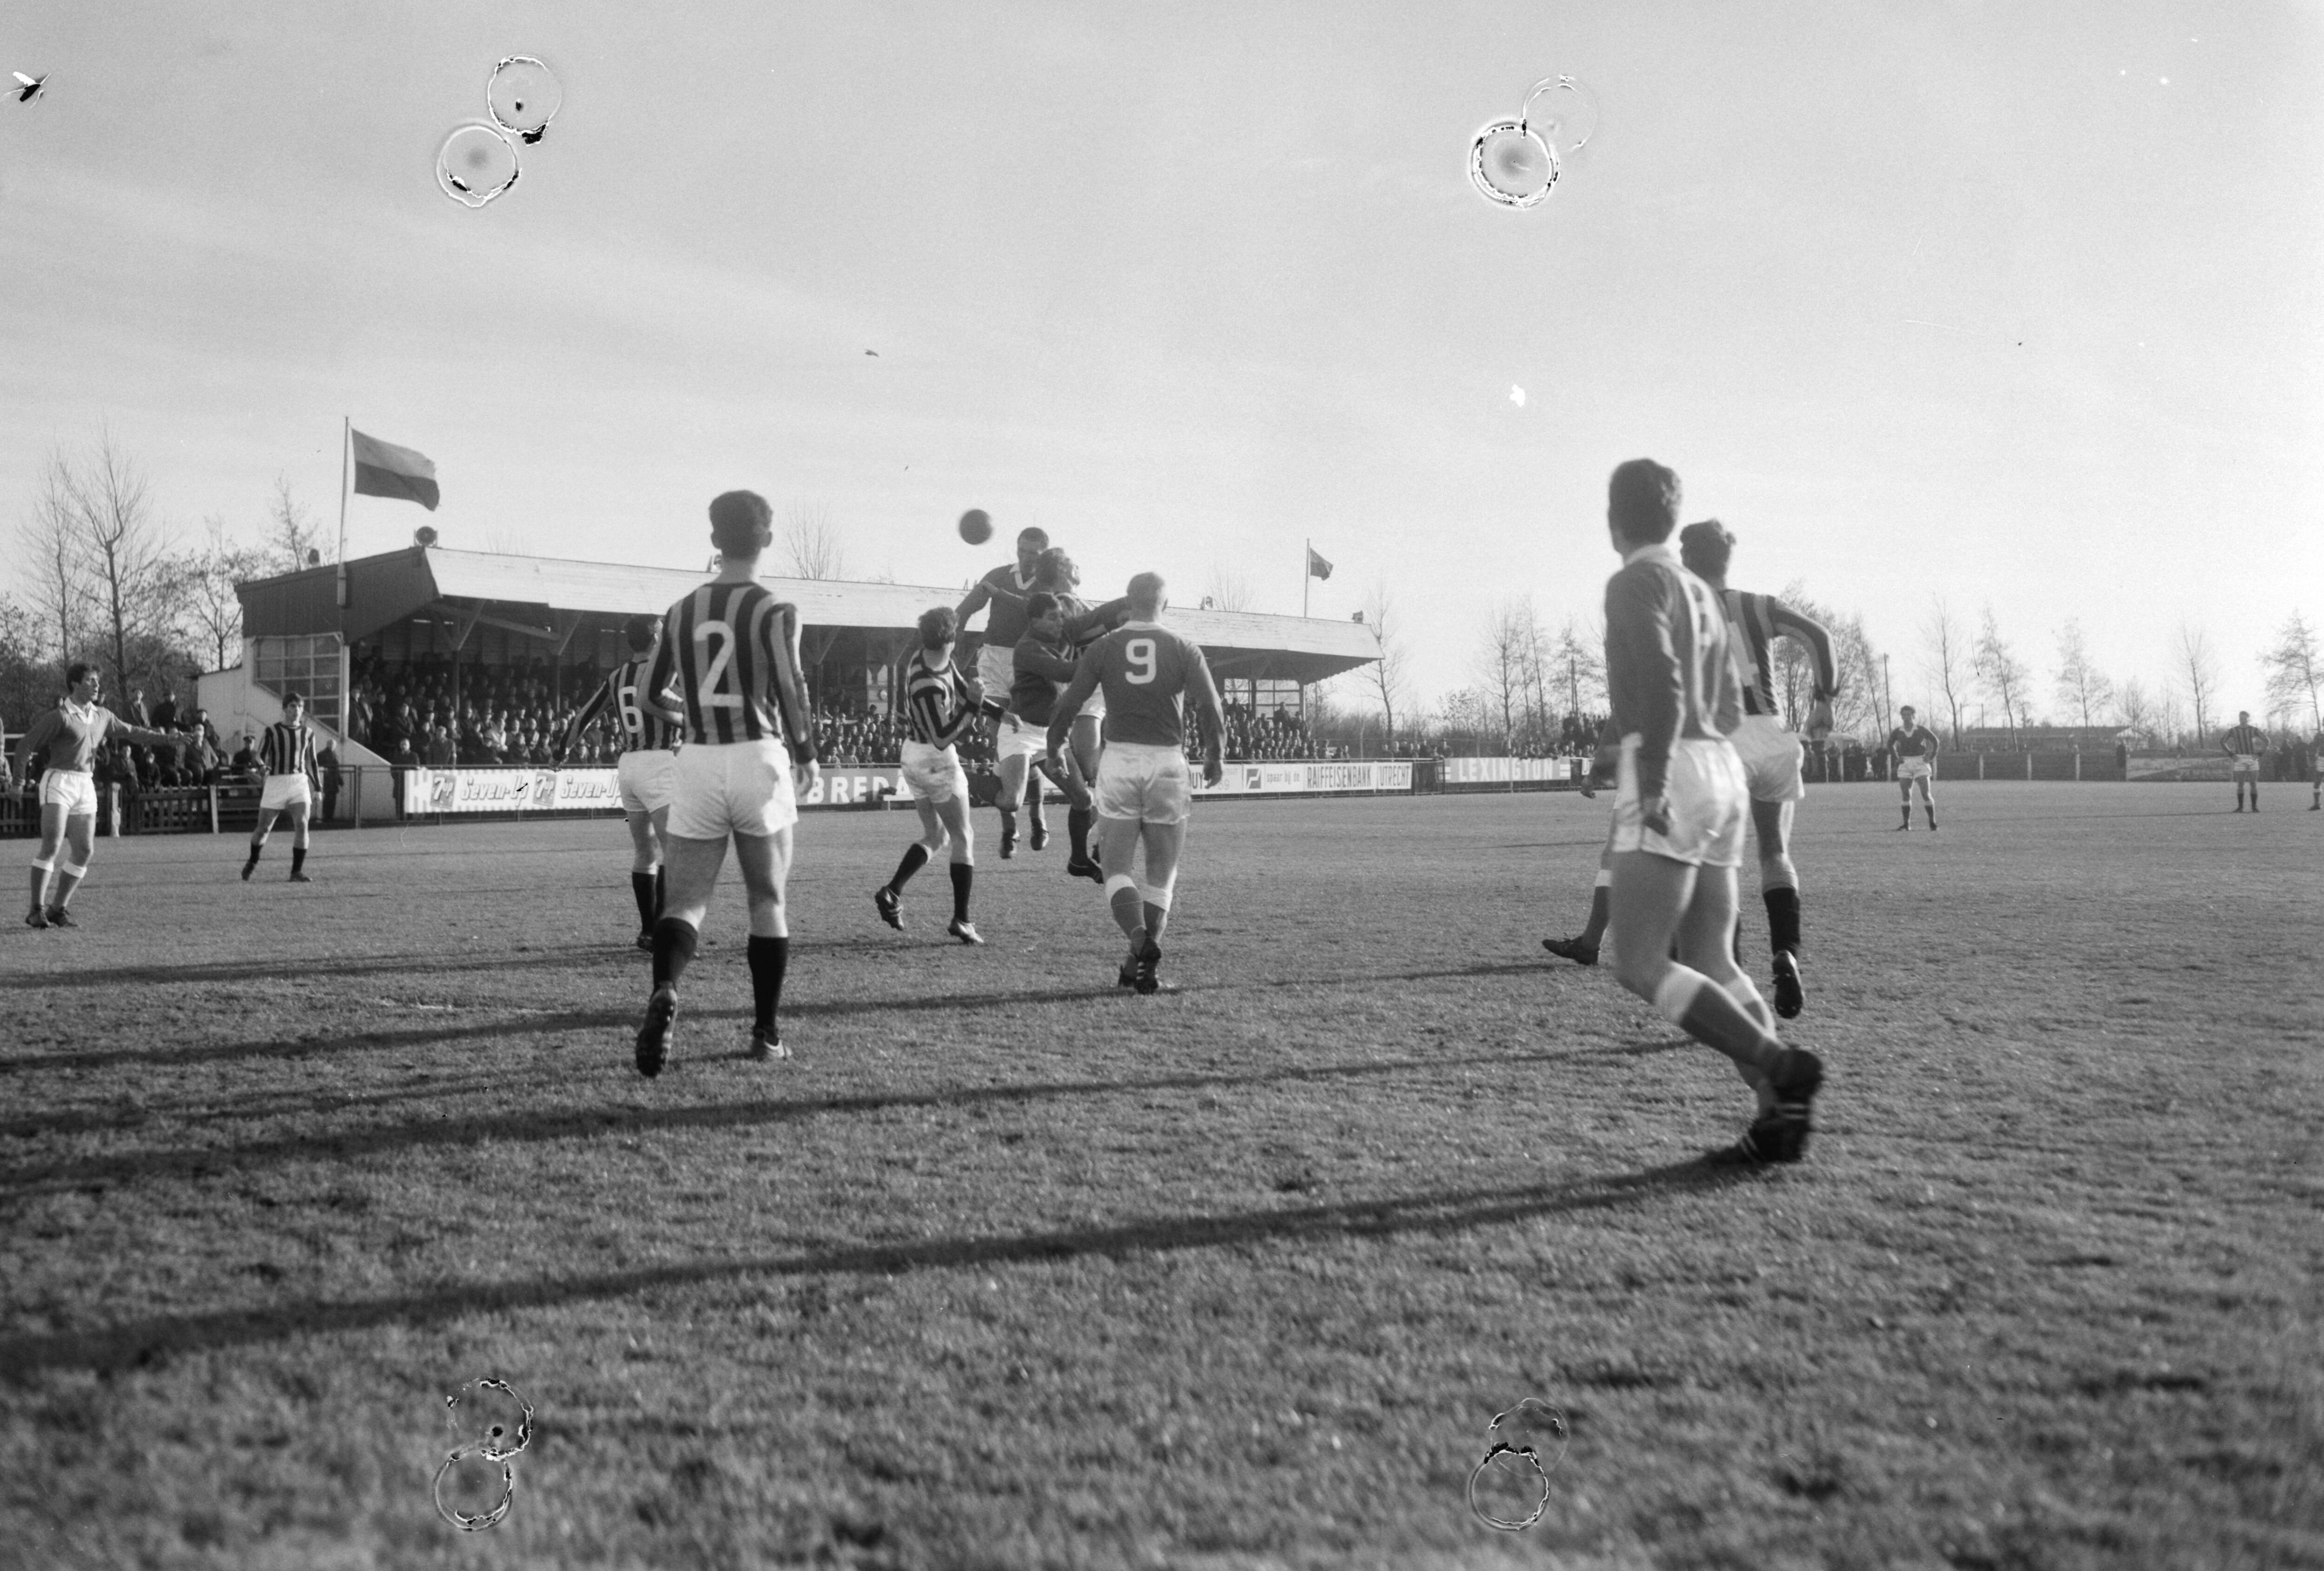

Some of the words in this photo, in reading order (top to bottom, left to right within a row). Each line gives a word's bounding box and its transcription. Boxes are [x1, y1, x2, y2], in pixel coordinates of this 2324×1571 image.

[694, 620, 744, 707] 2
[1125, 638, 1157, 685] 9
[618, 686, 644, 733] 6
[1307, 766, 1371, 789] RAIFFEISENBANK
[1380, 765, 1410, 787] UTRECHT
[1459, 758, 1553, 782] LEXINGTON
[461, 775, 529, 808] Seven-Up
[807, 776, 911, 804] BREDA
